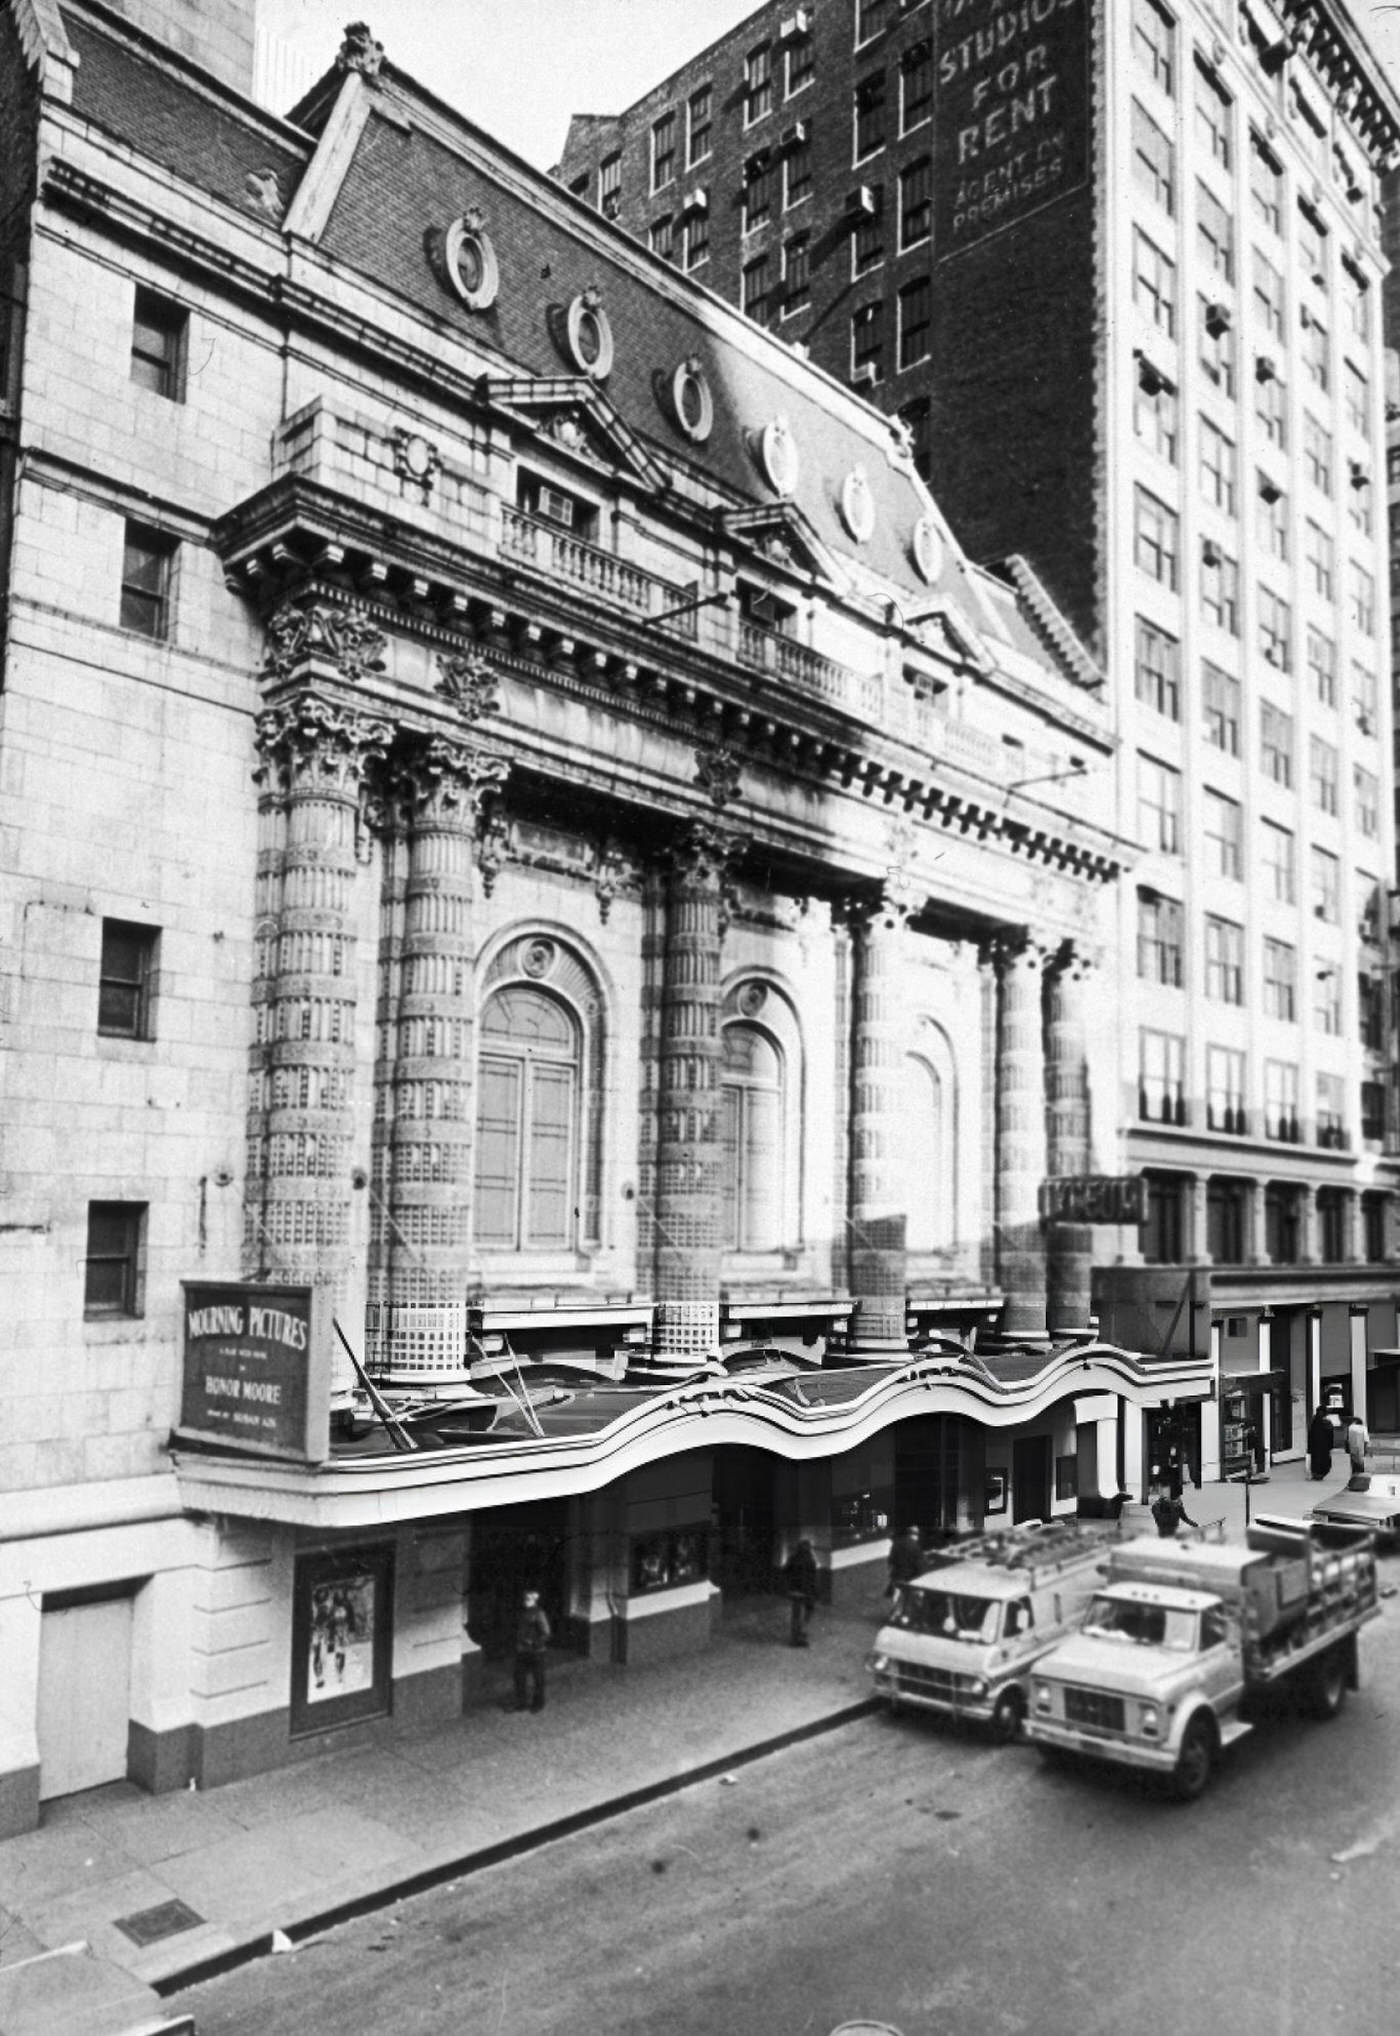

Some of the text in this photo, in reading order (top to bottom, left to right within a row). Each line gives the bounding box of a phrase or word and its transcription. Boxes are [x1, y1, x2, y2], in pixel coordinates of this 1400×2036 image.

[941, 0, 1073, 84] STUDIO
[972, 44, 1047, 111] FOR
[958, 74, 1057, 165] RENT
[188, 1305, 307, 1350] MOURNING PICTURES
[243, 1381, 281, 1405] MOORE
